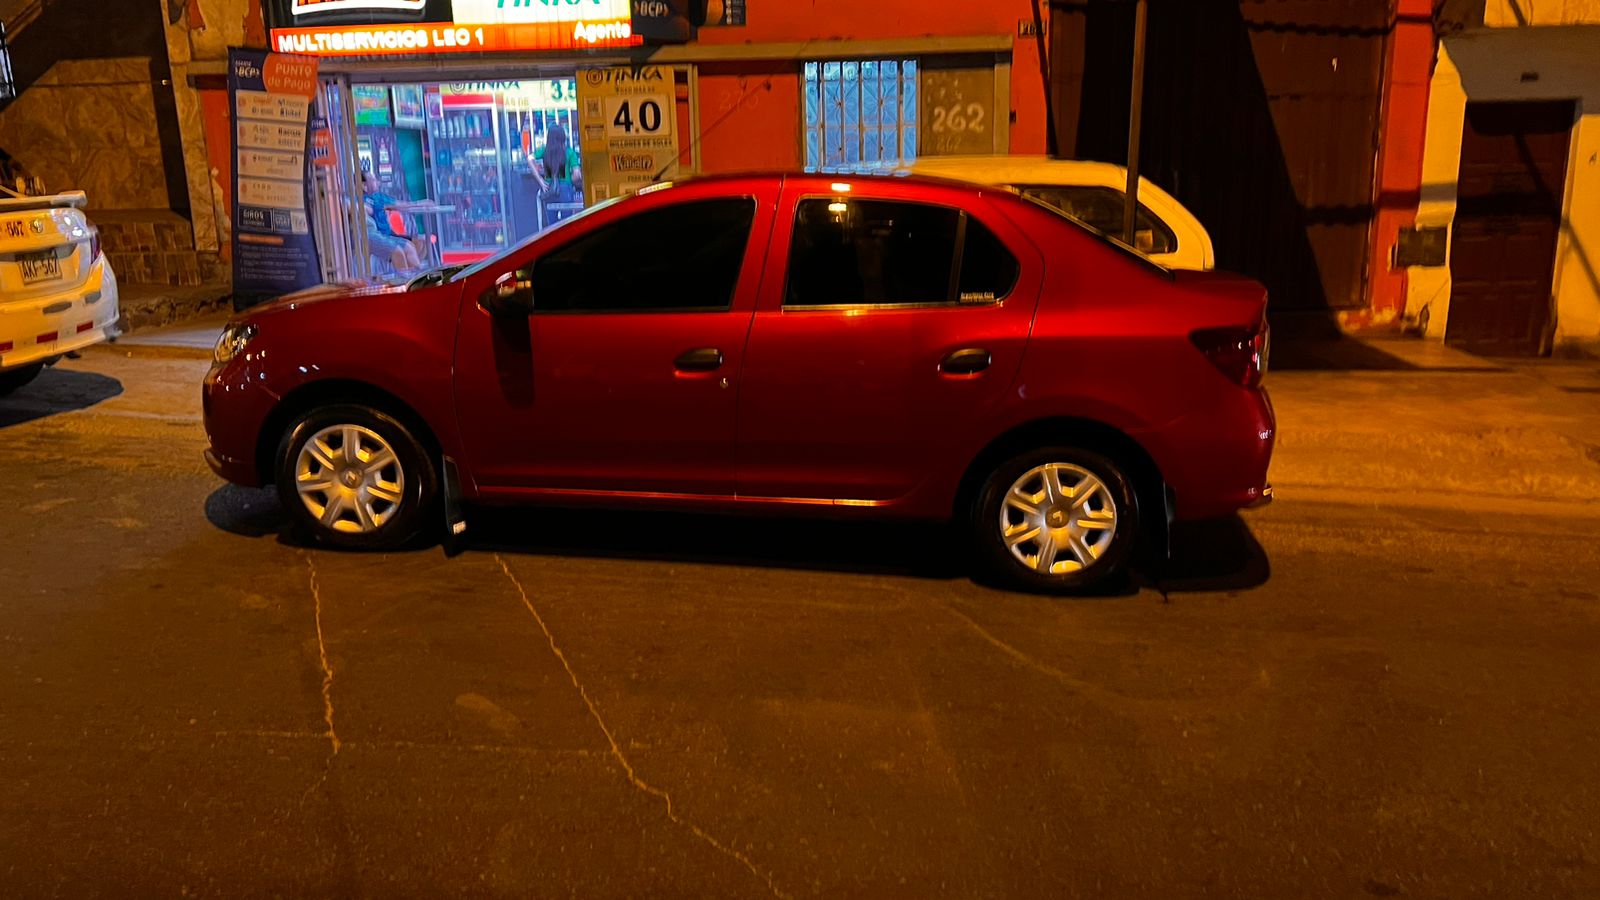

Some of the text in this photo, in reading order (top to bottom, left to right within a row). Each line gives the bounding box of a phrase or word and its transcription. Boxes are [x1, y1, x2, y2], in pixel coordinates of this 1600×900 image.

[278, 28, 484, 52] MULTISERVICIOS LEO 1
[574, 20, 631, 43] Agente
[276, 63, 312, 78] PUNTO
[284, 77, 311, 90] Pago
[613, 98, 661, 133] 4.0
[932, 102, 984, 132] 262
[0, 220, 24, 237] -567
